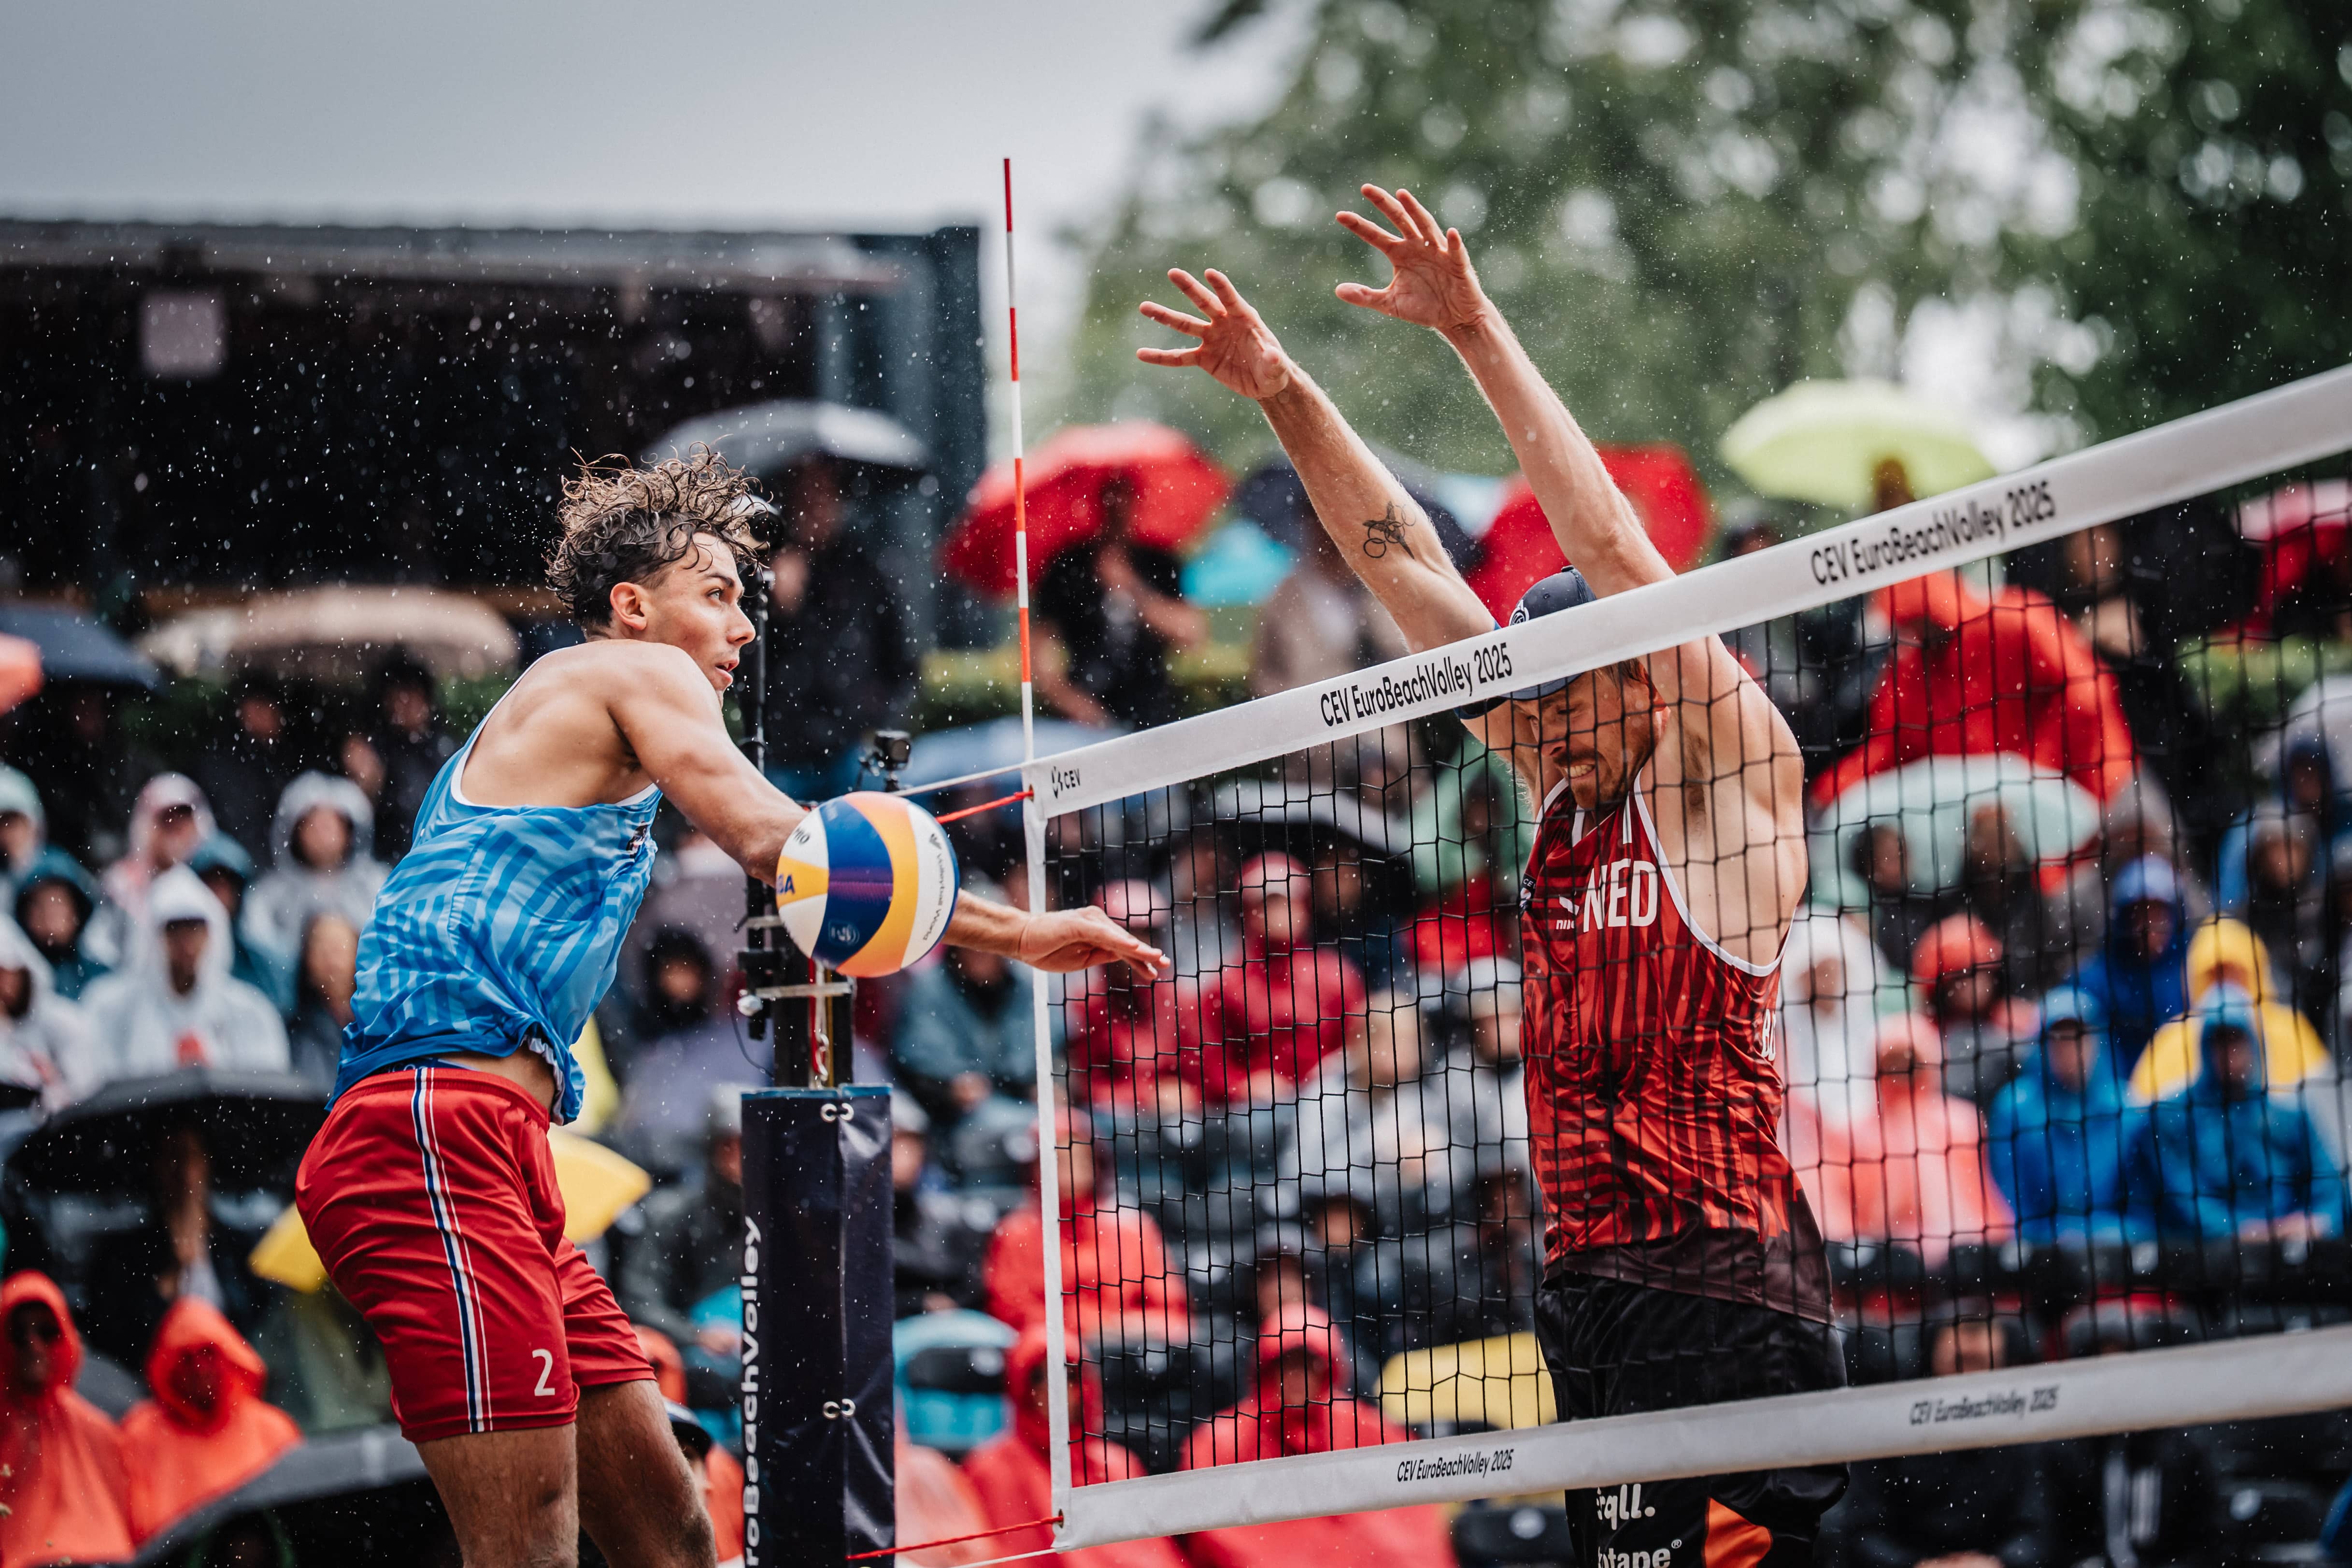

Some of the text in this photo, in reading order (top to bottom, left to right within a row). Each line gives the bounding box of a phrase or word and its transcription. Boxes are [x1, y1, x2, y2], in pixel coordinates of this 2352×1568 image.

[1810, 481, 2056, 584] CEV EuroBeachVolley 2025
[1321, 642, 1512, 727] CEV EuroBeachVolley 2025
[1064, 768, 1080, 789] CEV
[1583, 858, 1658, 933] NED
[532, 1349, 555, 1397] 2
[1397, 1449, 1514, 1482] CEV EuroBeachVolley 2025
